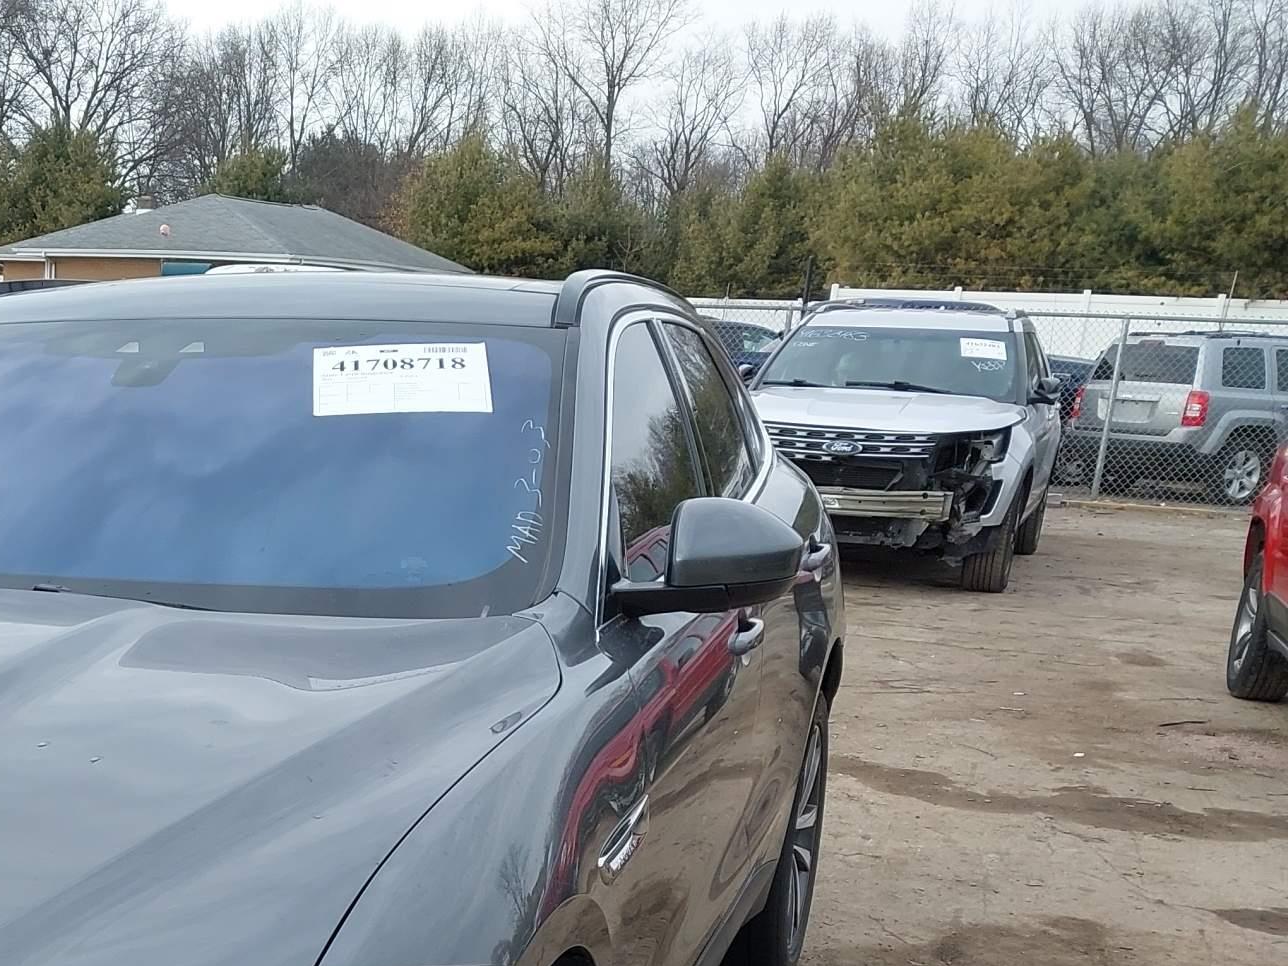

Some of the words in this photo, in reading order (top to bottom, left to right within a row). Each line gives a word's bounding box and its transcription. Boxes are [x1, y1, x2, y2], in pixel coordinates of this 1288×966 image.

[331, 357, 467, 372] 41708718
[830, 442, 854, 452] Ford
[505, 511, 544, 564] MAD
